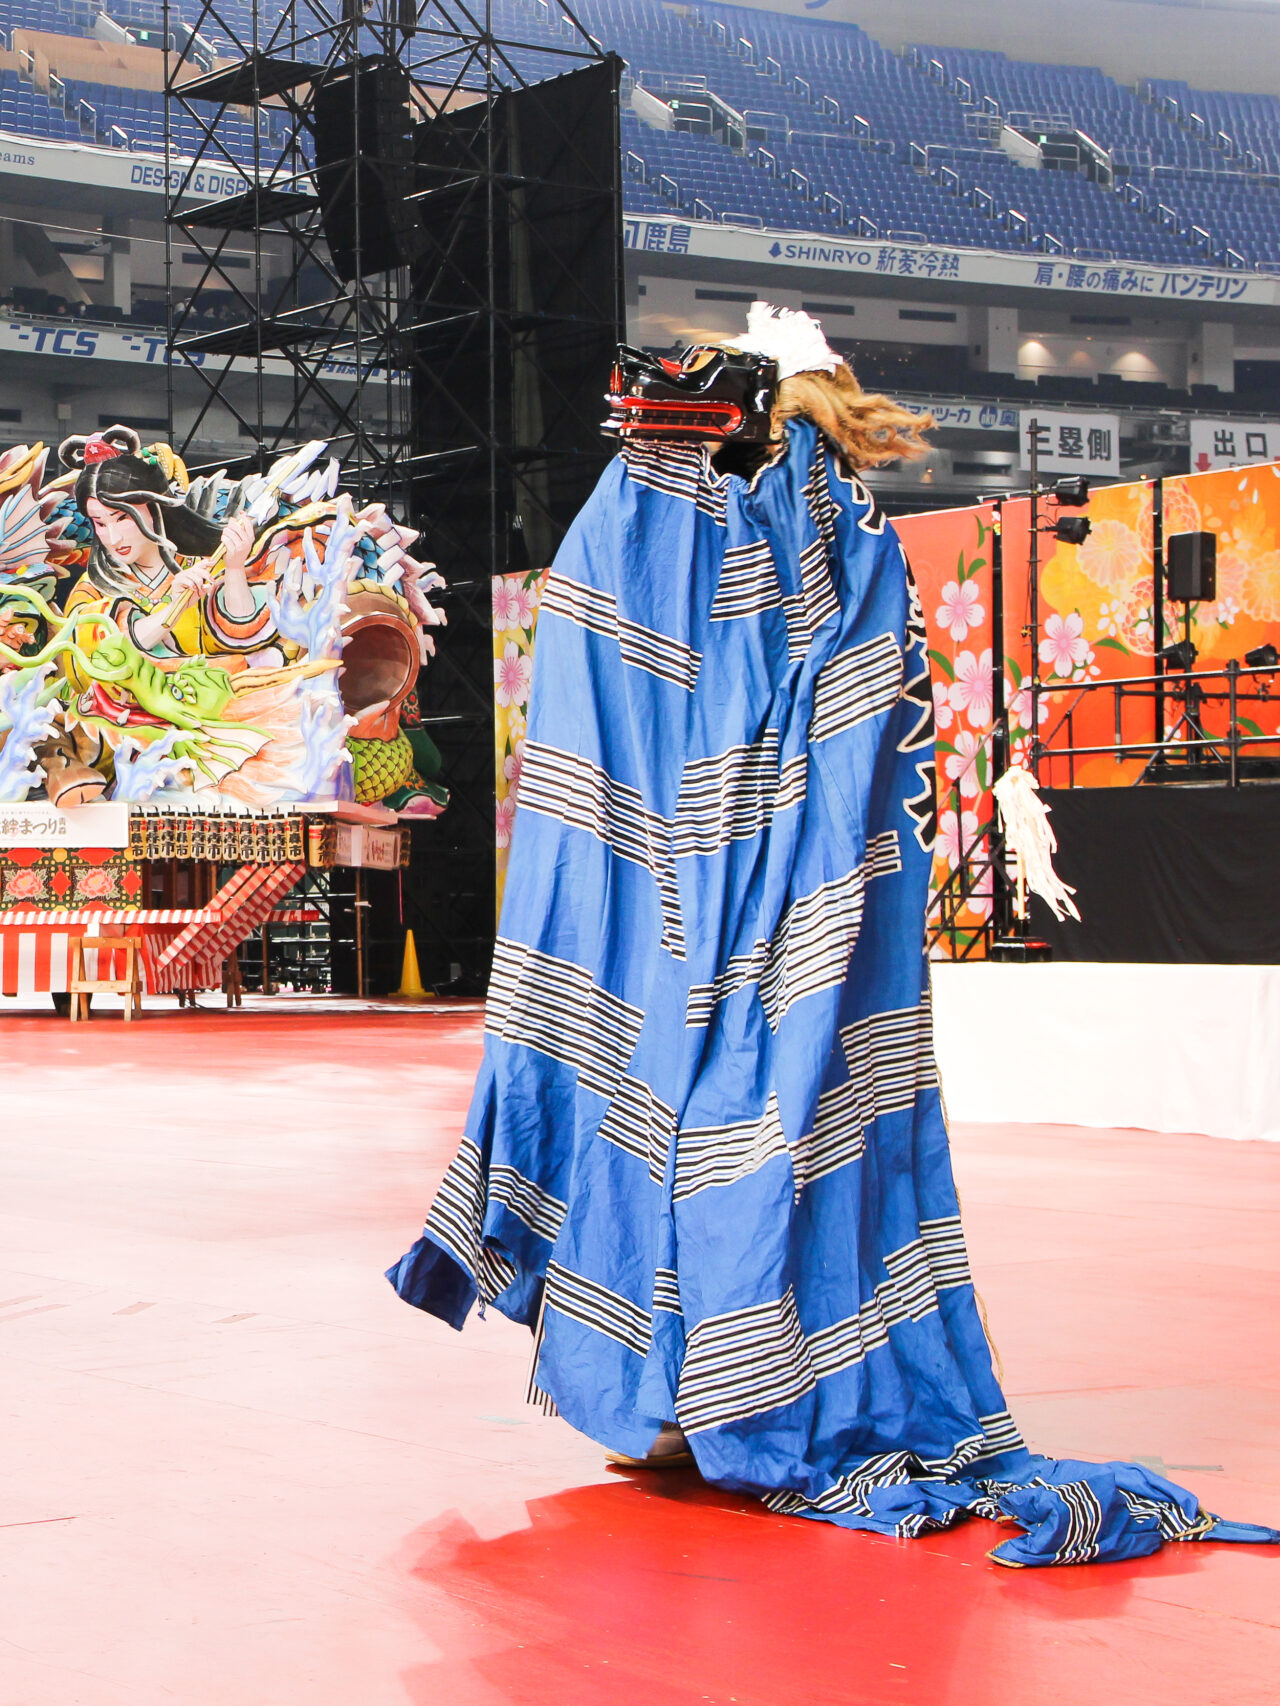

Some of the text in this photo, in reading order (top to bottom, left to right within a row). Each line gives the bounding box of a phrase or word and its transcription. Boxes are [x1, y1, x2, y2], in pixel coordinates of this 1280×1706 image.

[131, 165, 191, 191] DESGN
[194, 174, 205, 192] &
[785, 244, 960, 277] SHINRYO 新菱冷熱
[1034, 262, 1154, 293] 肩・腰の痛みに
[1027, 425, 1112, 461] 三塁側
[1214, 429, 1268, 458] 出口
